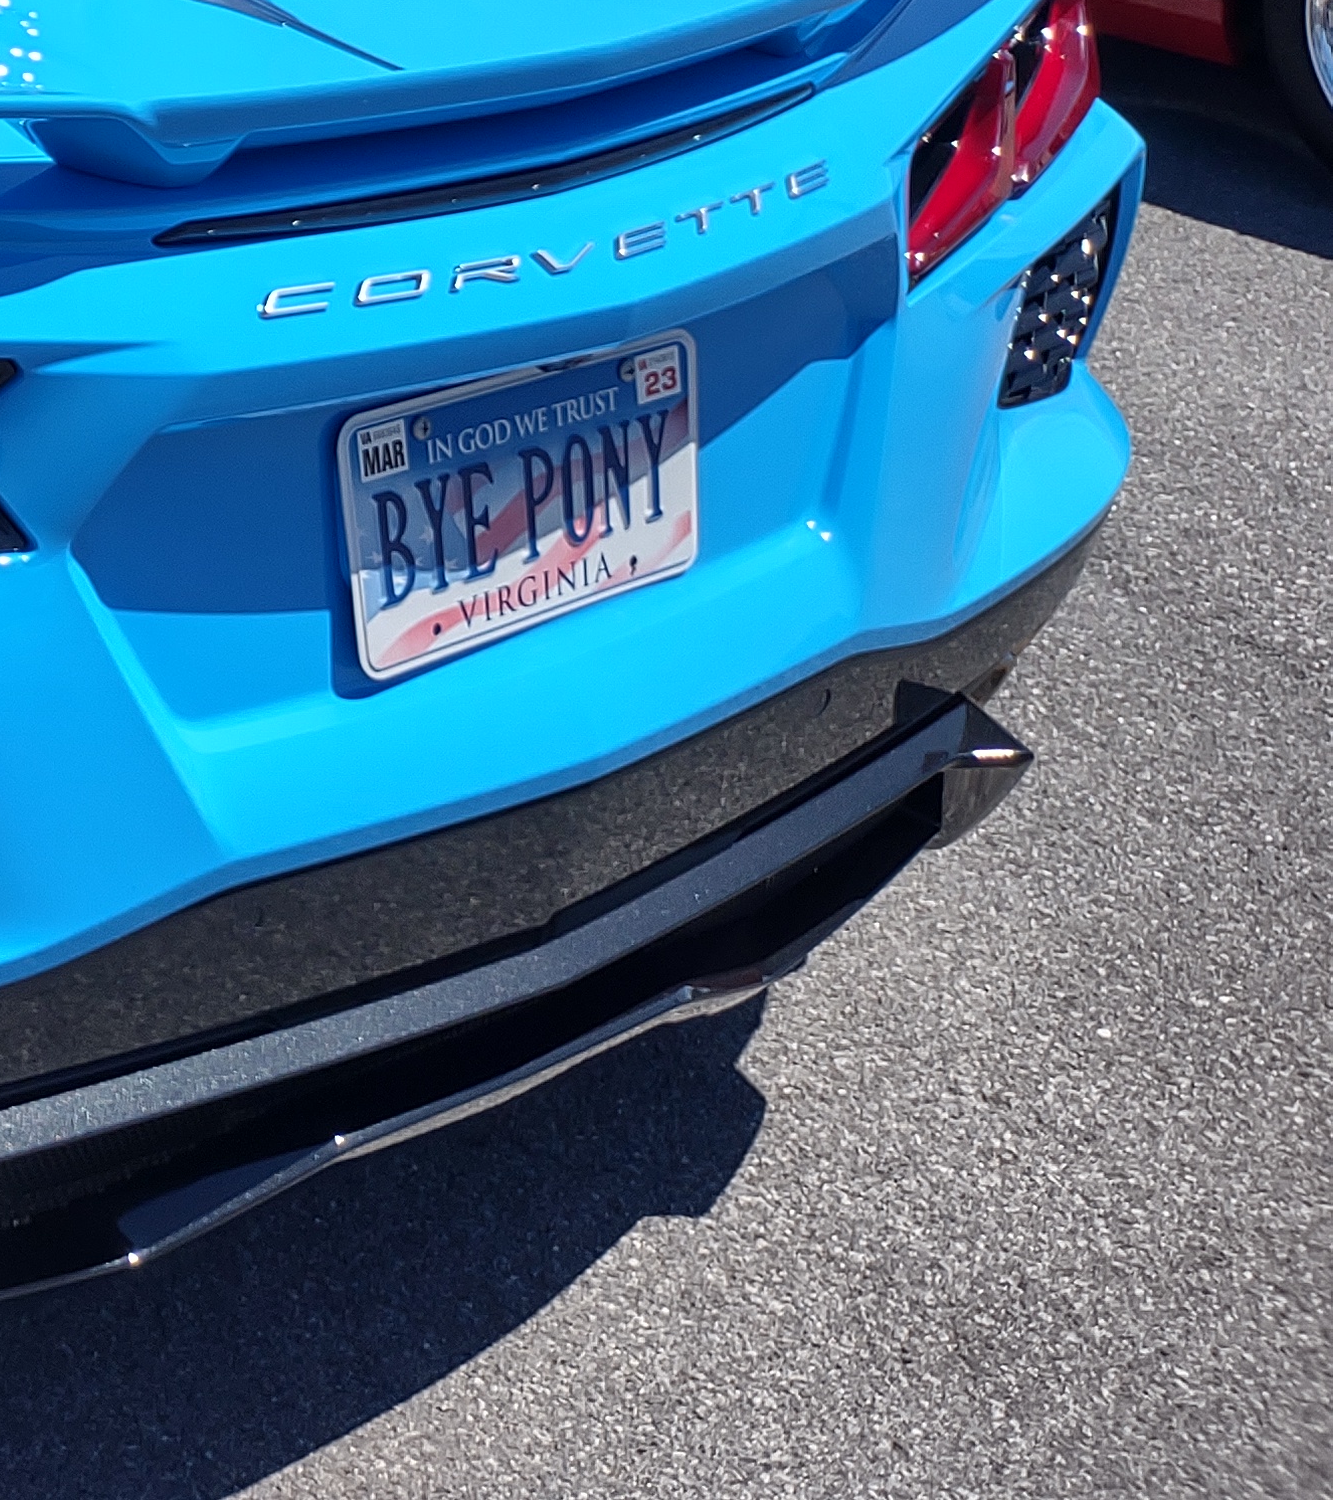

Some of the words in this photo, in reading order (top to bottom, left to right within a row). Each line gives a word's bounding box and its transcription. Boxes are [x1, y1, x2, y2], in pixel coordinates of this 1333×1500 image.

[257, 160, 828, 317] CORVETTE
[644, 365, 678, 398] 23
[361, 438, 406, 478] MAR
[426, 433, 454, 465] IN
[457, 419, 511, 455] GOD
[514, 408, 549, 438] WE
[551, 388, 618, 427] TRUST
[372, 462, 498, 610] BYE
[518, 411, 668, 563] PONY
[456, 551, 613, 628] VIRGINIA
